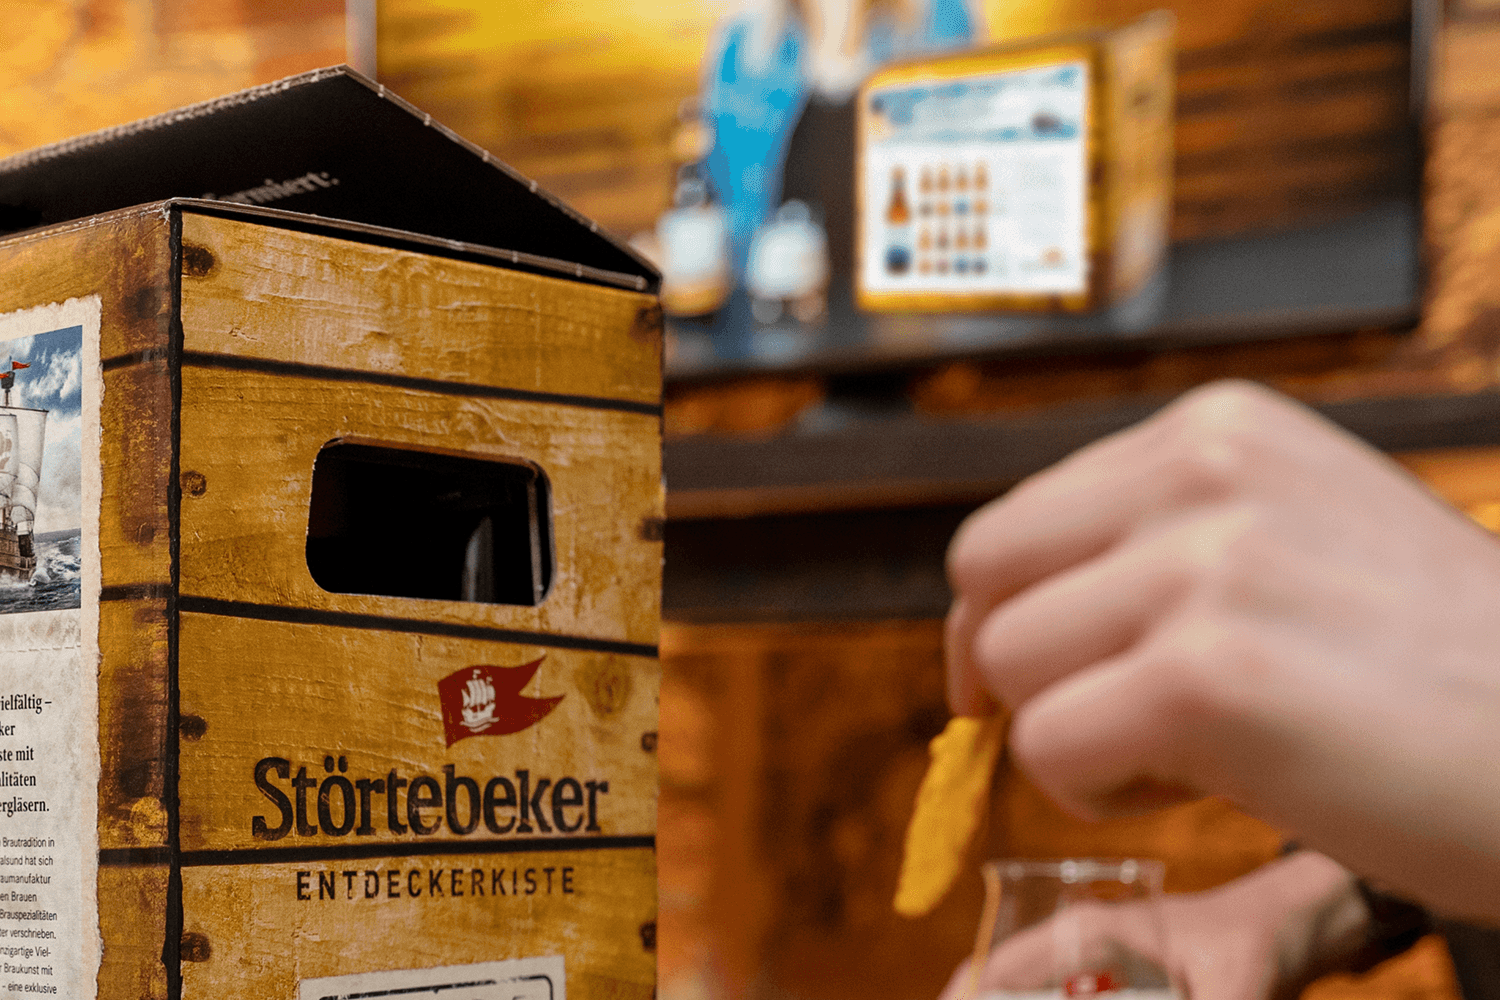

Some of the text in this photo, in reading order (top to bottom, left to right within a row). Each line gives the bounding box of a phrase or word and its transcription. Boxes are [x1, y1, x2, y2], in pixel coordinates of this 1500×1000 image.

[15, 745, 34, 761] mit
[252, 755, 609, 841] Störtebeker
[2, 836, 47, 848] Brautradition
[48, 836, 55, 847] in
[25, 855, 37, 866] hat
[38, 855, 53, 866] sich
[296, 867, 576, 901] ENTDECKERKISTE
[11, 891, 38, 902] Brauen
[0, 909, 58, 922] Brauspezialitäten
[10, 928, 56, 939] verschrieben.
[35, 946, 51, 958] Viel-
[4, 962, 39, 975] Braukunst
[41, 965, 53, 976] mit
[8, 981, 23, 992] eine
[24, 982, 57, 995] exklusive
